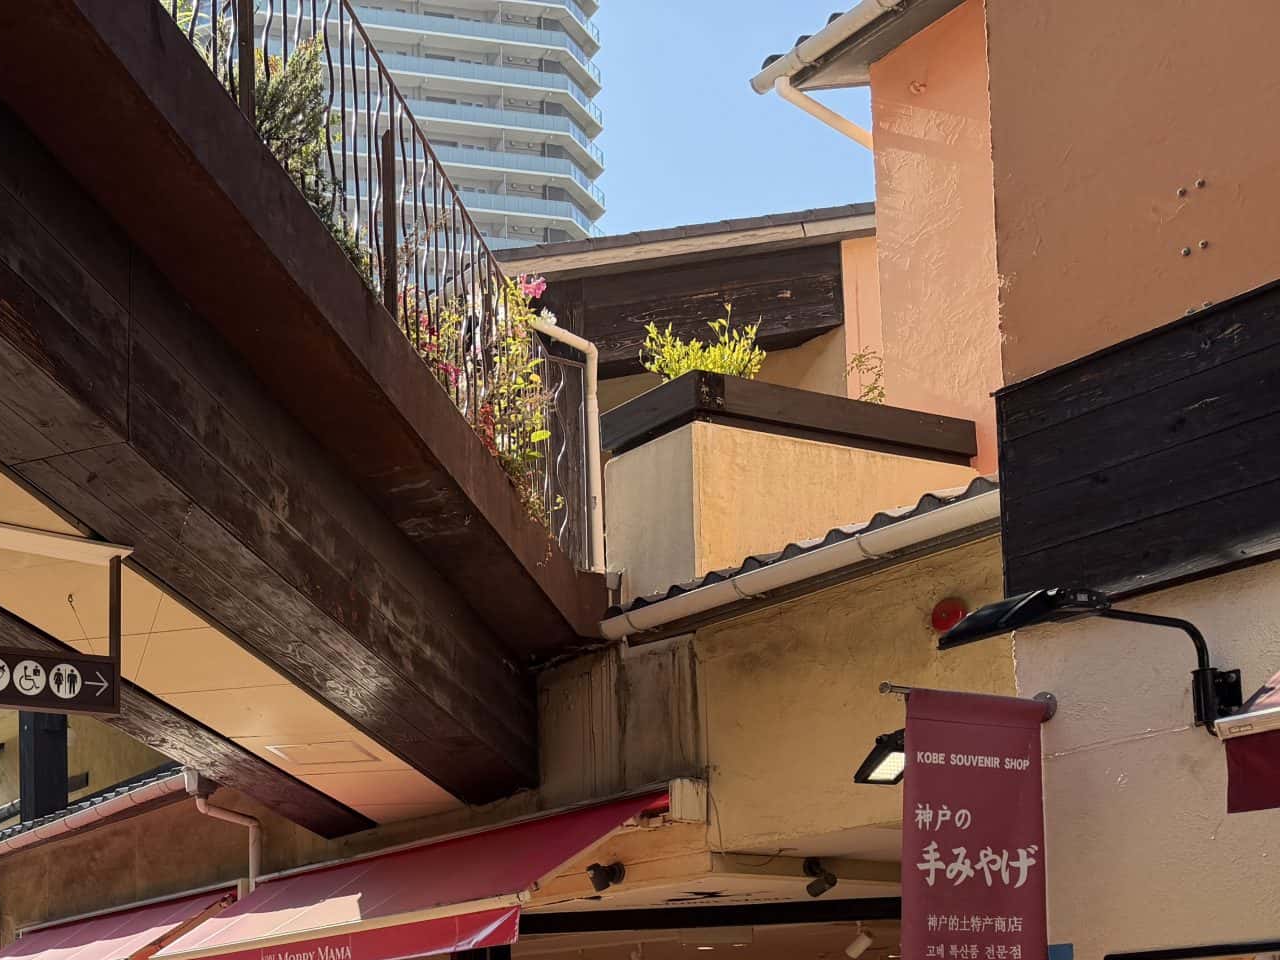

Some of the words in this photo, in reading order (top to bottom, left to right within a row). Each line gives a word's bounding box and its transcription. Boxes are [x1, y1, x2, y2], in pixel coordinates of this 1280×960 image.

[916, 751, 946, 765] KOBE
[949, 753, 1001, 768] SOUVENIR
[1004, 757, 1030, 771] SHOP
[914, 802, 972, 832] 神戸の
[916, 840, 1039, 889] 手みやげ
[925, 944, 945, 959] 고베
[949, 944, 980, 960] 특산품
[984, 944, 1023, 960] 전문점
